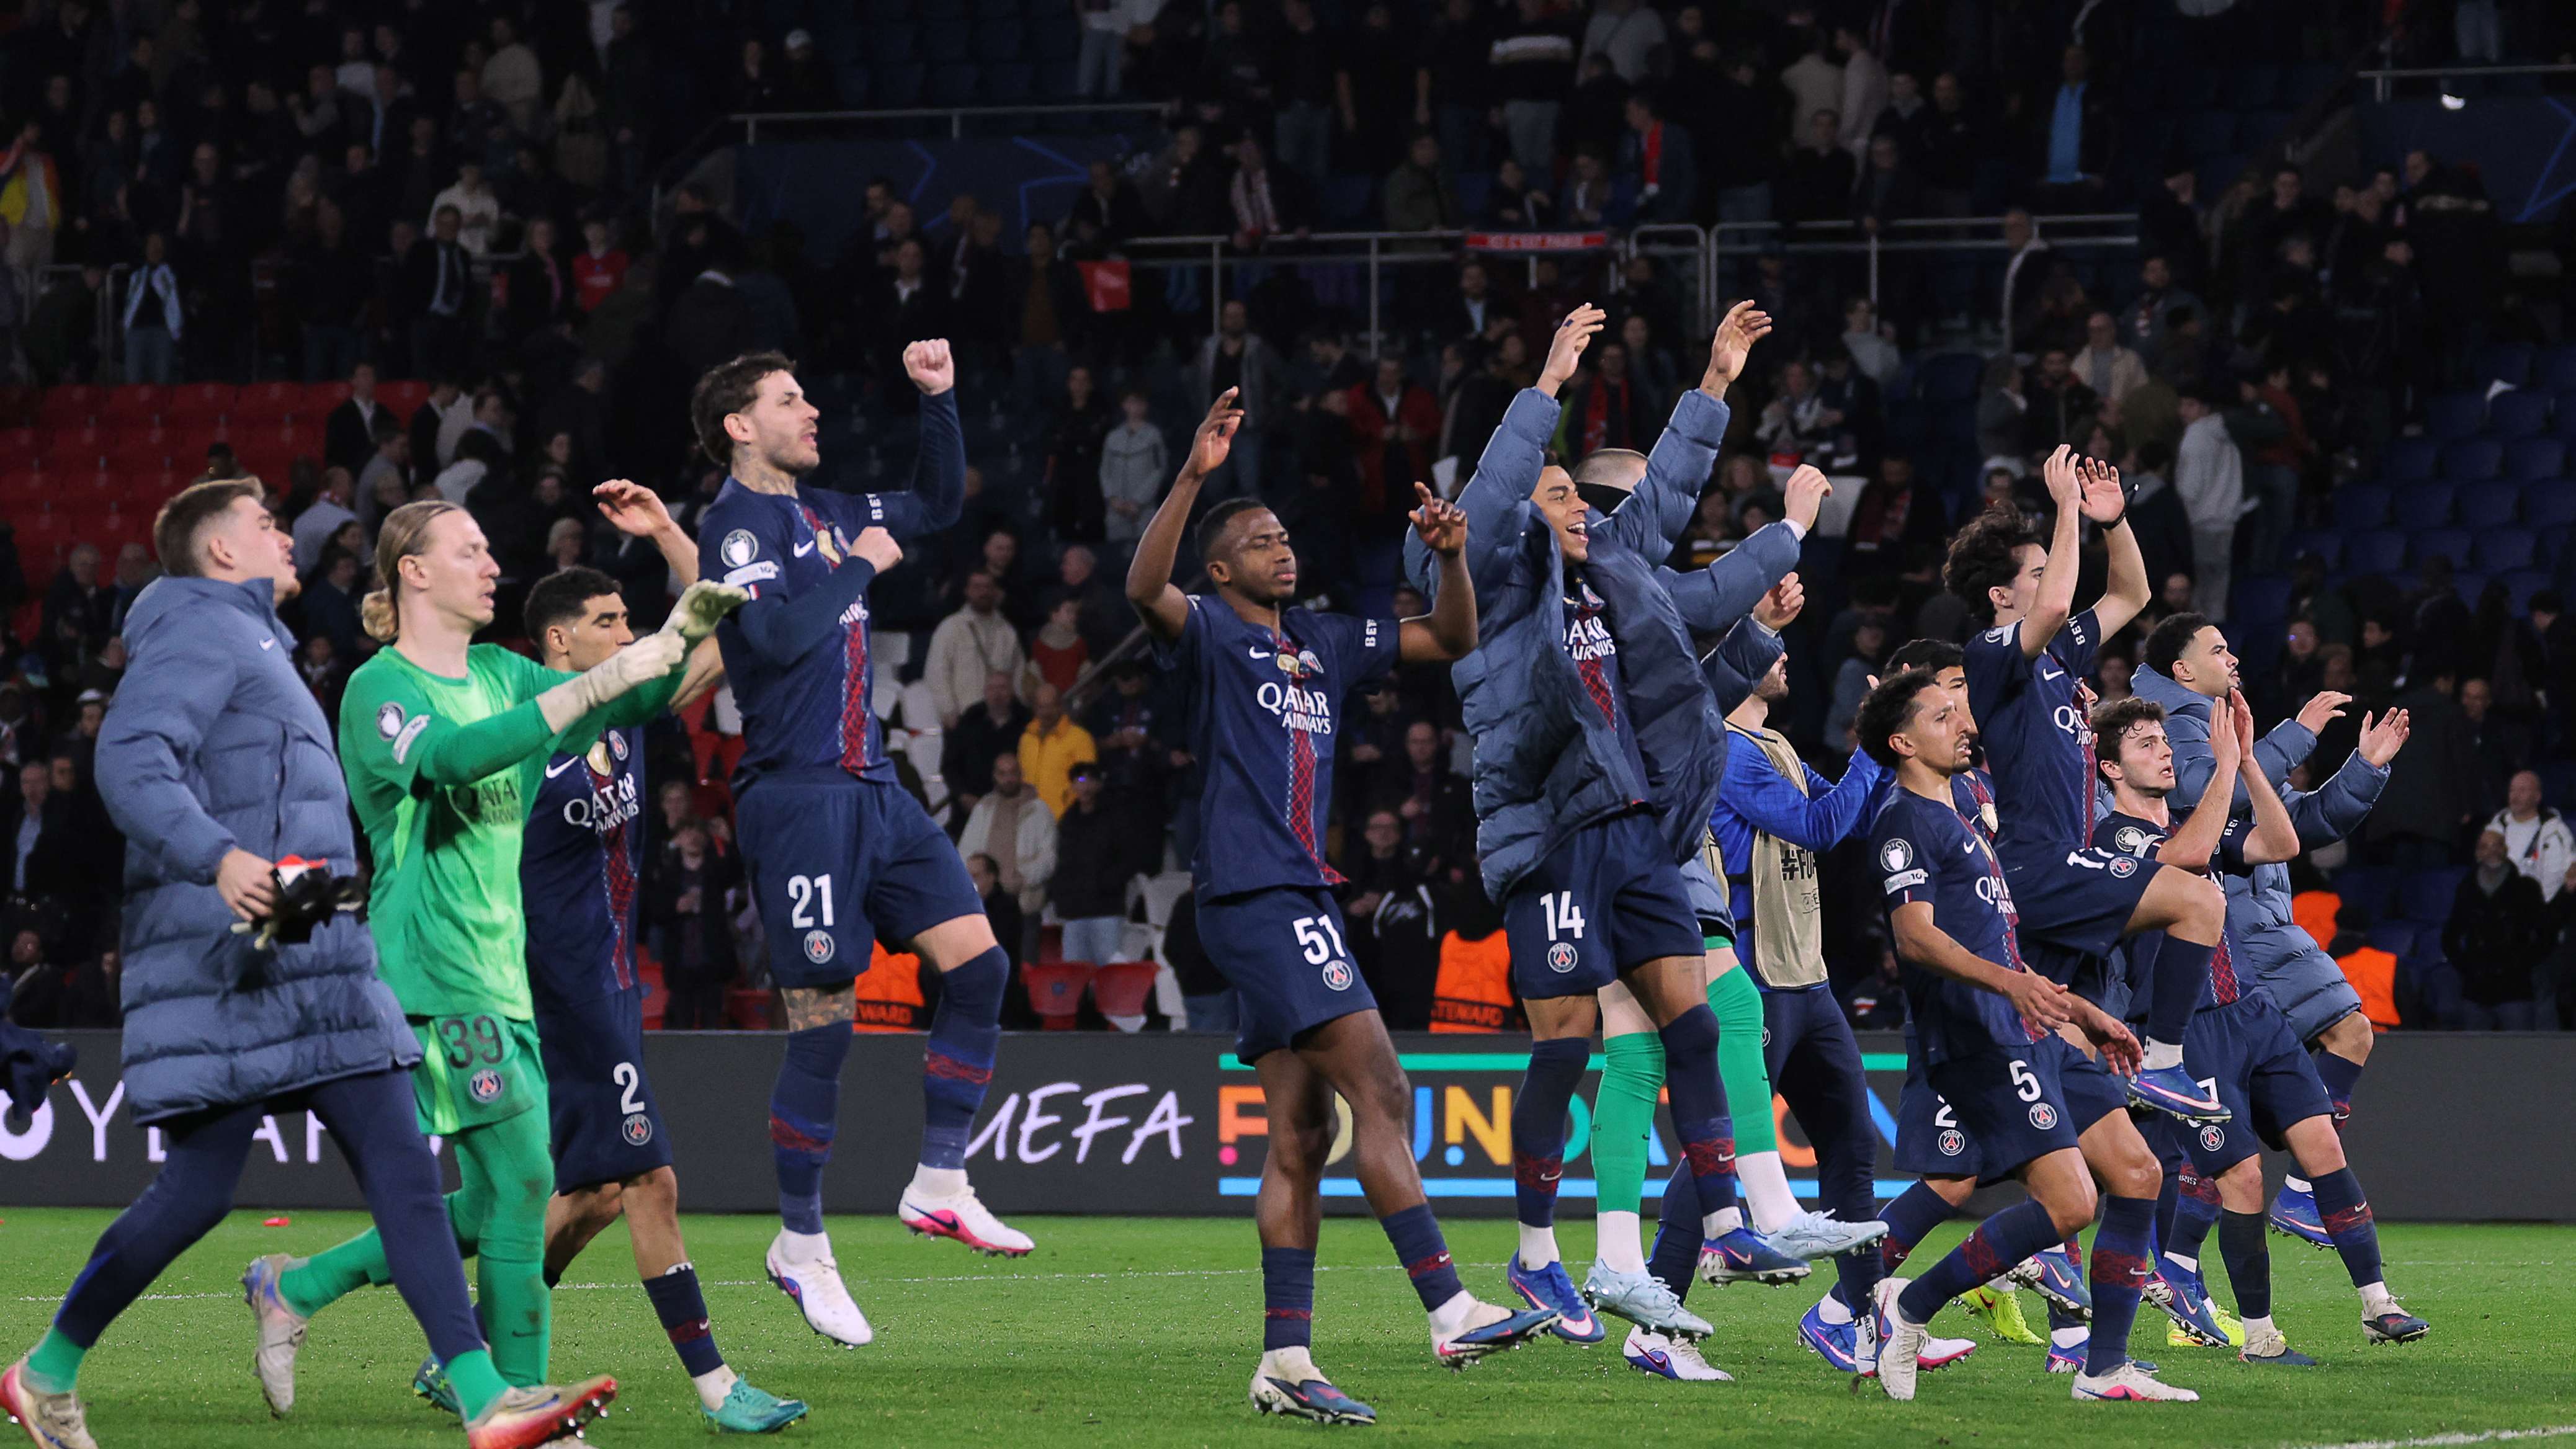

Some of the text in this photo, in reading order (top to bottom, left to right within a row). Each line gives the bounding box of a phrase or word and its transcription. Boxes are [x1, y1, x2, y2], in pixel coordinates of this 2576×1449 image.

[1257, 682, 1330, 717] QATAR
[563, 772, 637, 828] QATAR
[787, 873, 834, 929] 21
[1975, 875, 2011, 905] QATA
[1292, 914, 1346, 965] 51
[1540, 891, 1585, 941] 14
[442, 1015, 504, 1069] 39
[613, 1061, 646, 1115] 2
[2009, 1059, 2042, 1102] 5
[964, 1082, 1194, 1164] UEFA
[2178, 1174, 2198, 1186] ARIS
